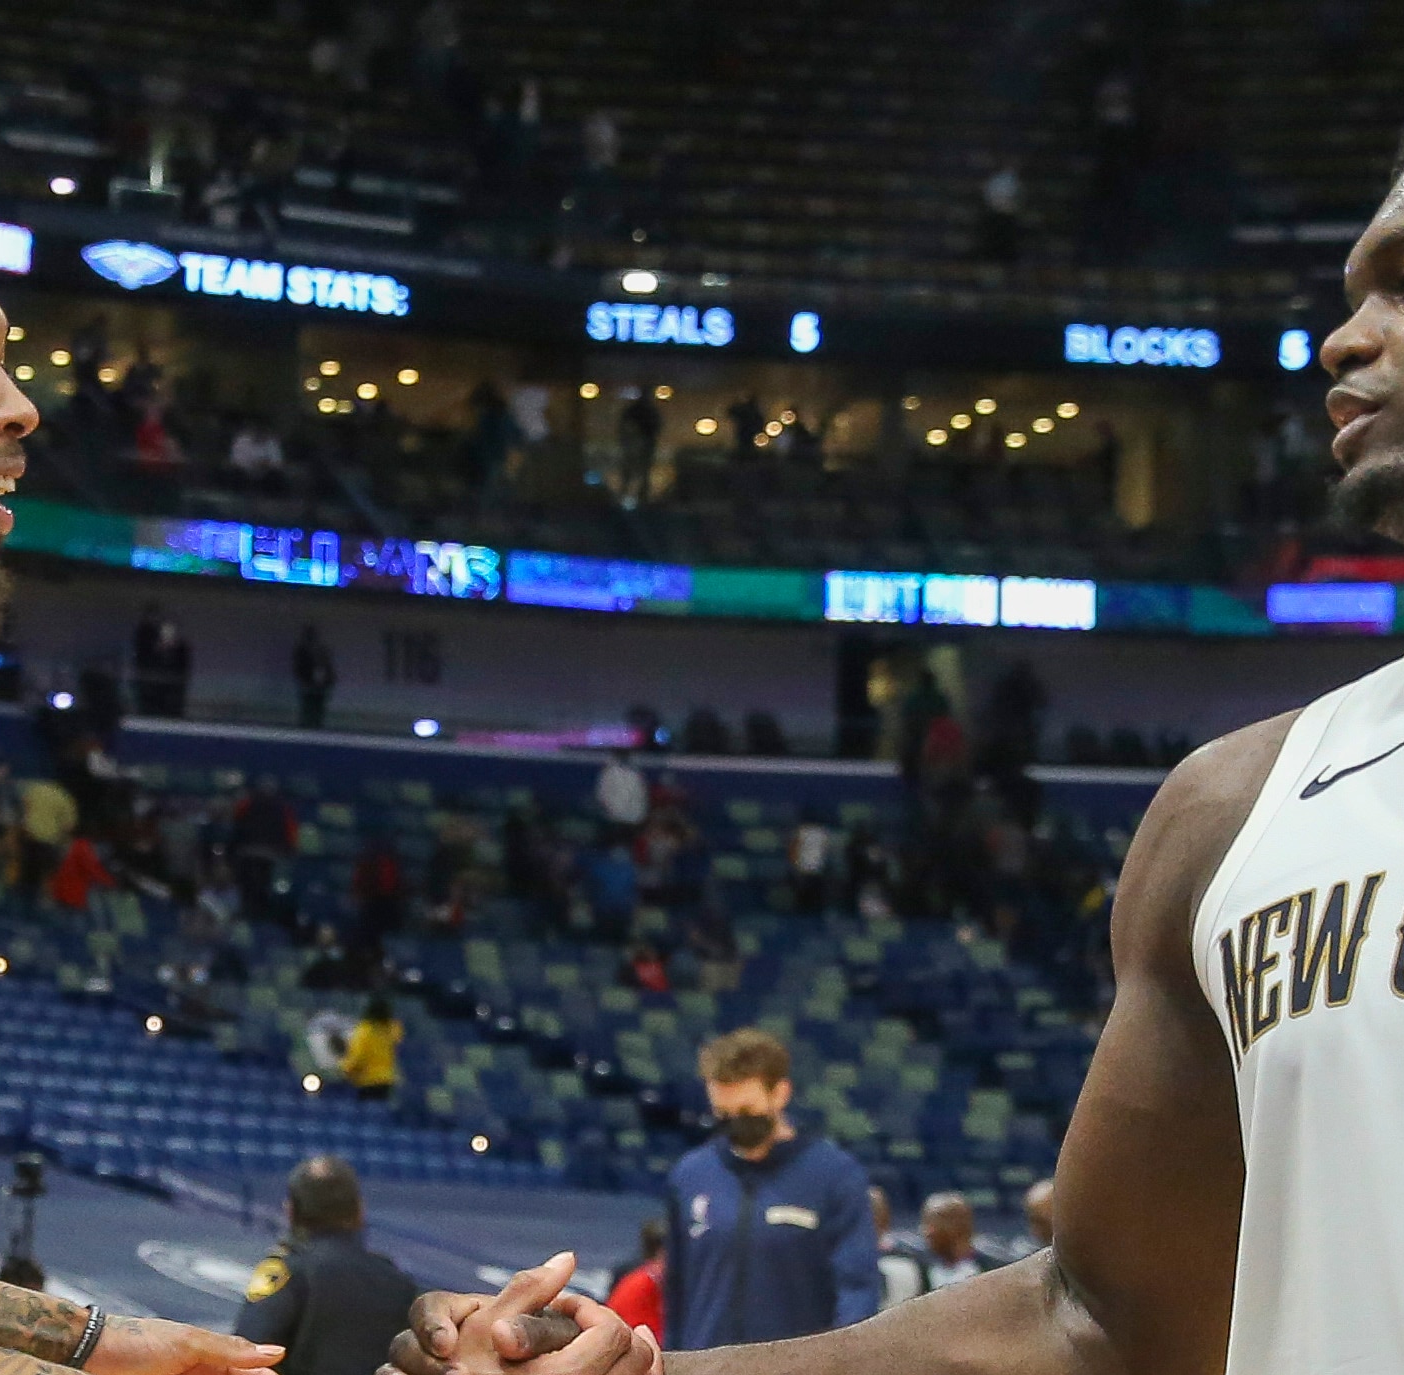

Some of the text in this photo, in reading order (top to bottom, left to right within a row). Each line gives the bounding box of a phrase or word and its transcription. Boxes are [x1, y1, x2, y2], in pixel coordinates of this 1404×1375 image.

[178, 251, 409, 317] TEAM STATS:
[586, 301, 736, 347] STEALS
[1064, 323, 1221, 368] BLOCKS
[1218, 870, 1387, 1071] NEW
